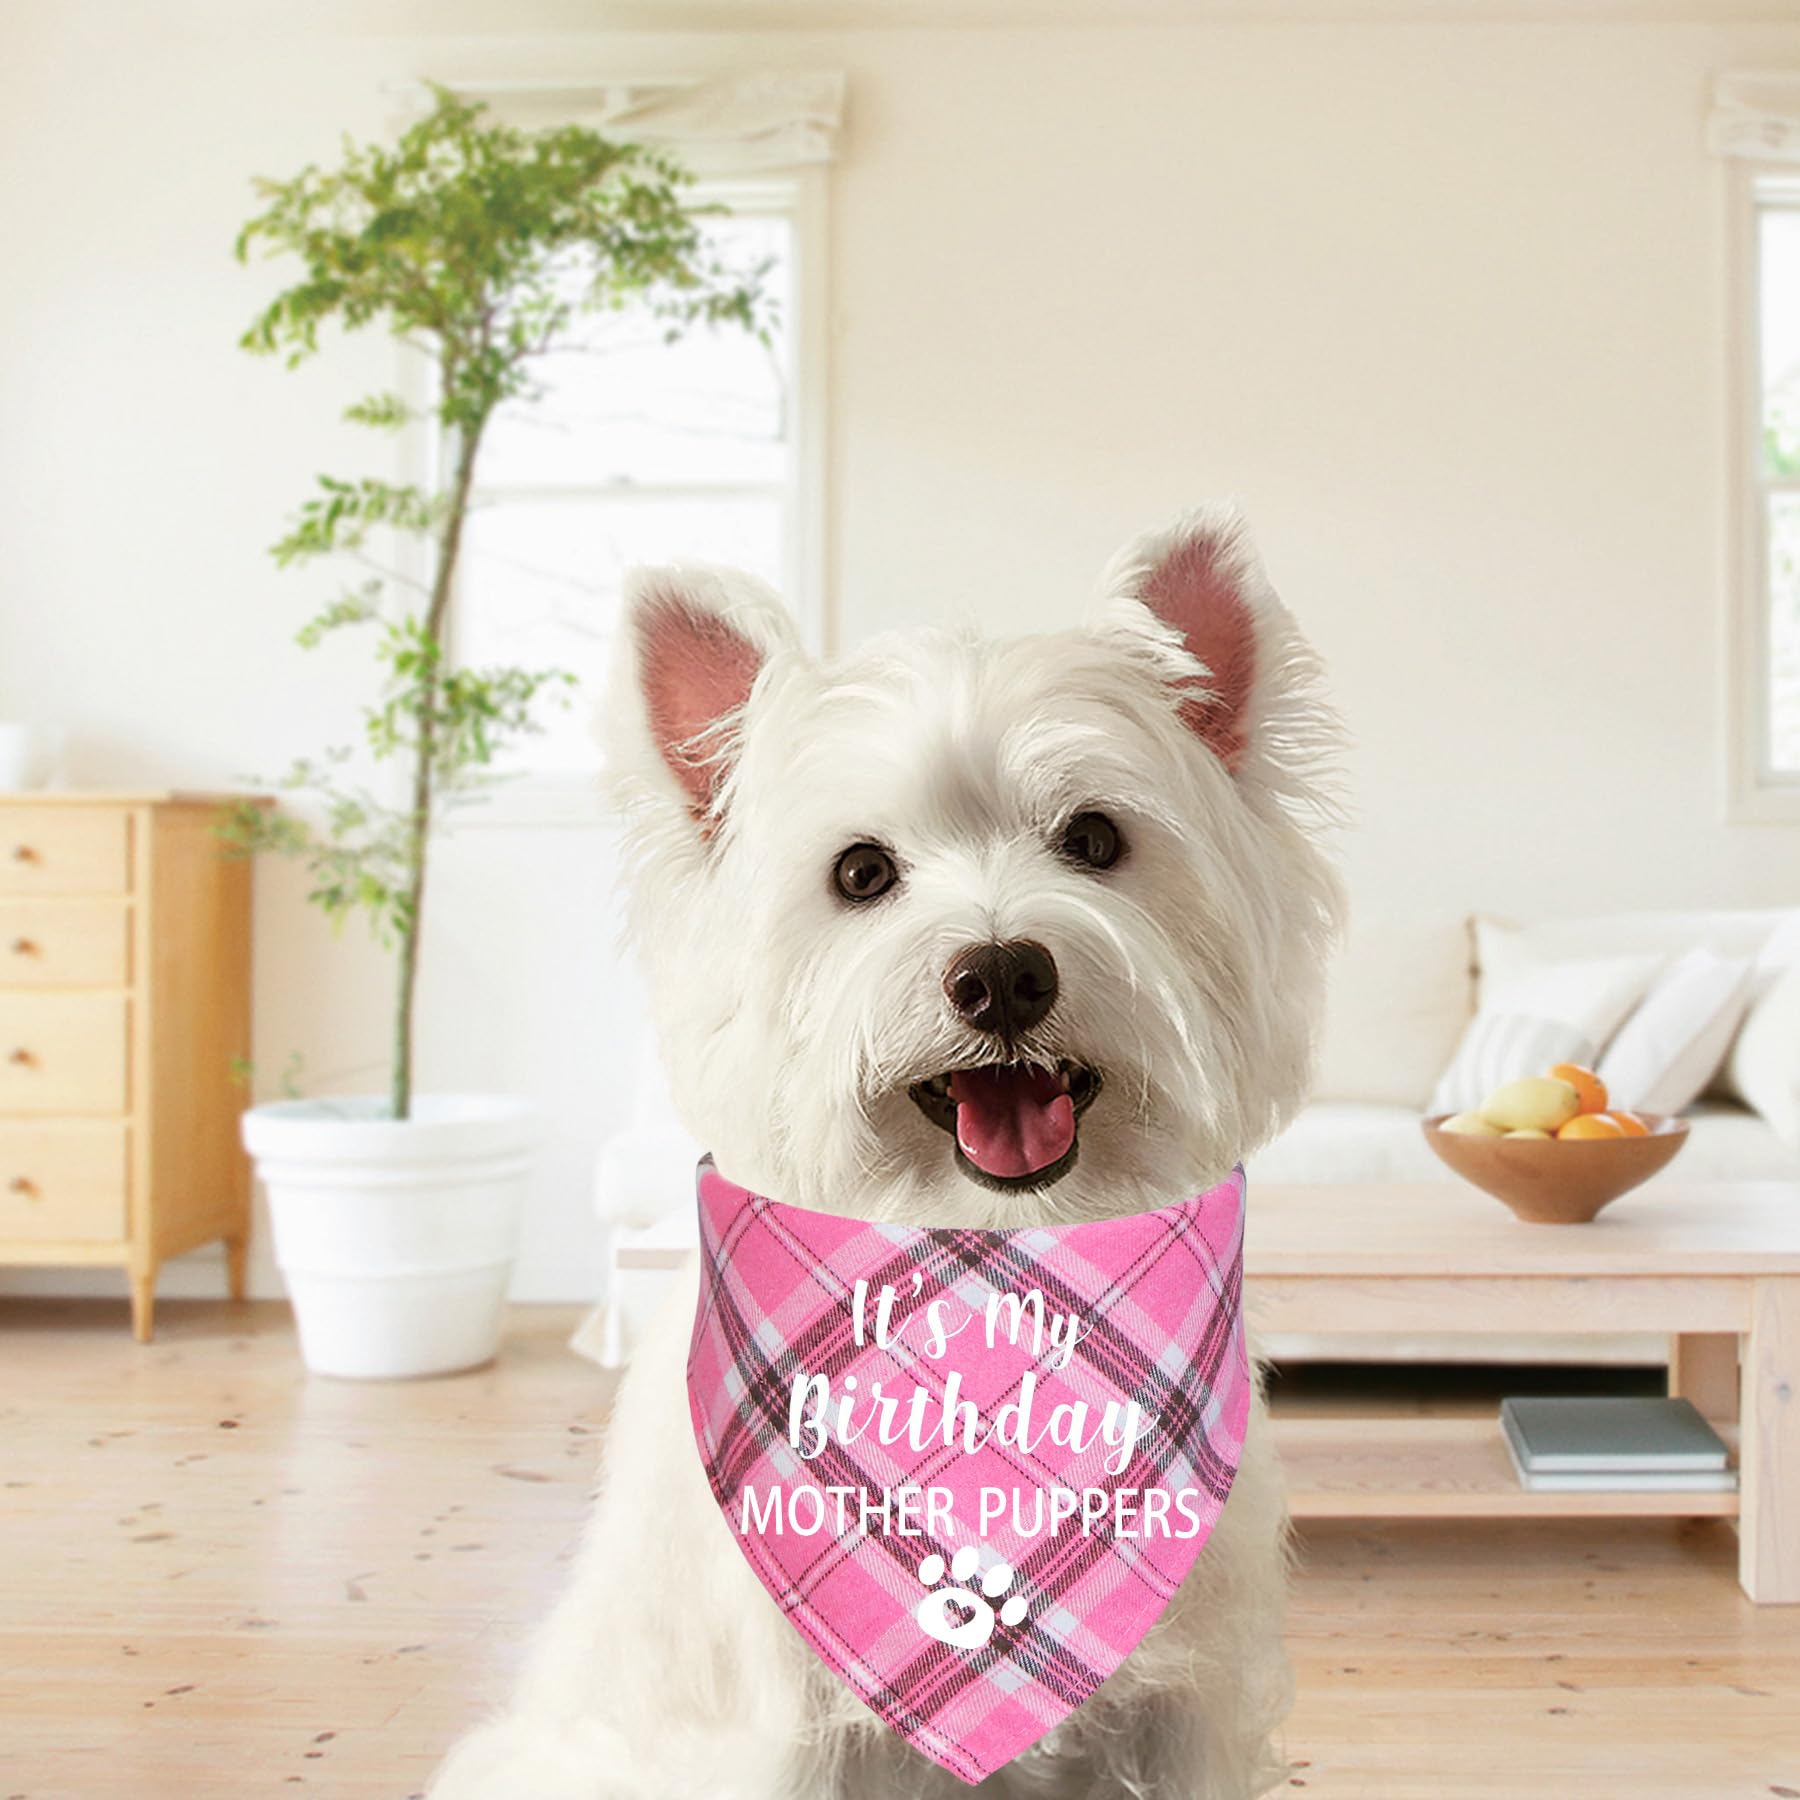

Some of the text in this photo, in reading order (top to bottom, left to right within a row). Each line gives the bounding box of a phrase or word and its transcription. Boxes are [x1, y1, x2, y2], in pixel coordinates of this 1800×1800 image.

[851, 1271, 1093, 1371] It's My
[788, 1370, 1161, 1476] Birthday
[740, 1485, 1201, 1540] MOTHER PUPPERS
